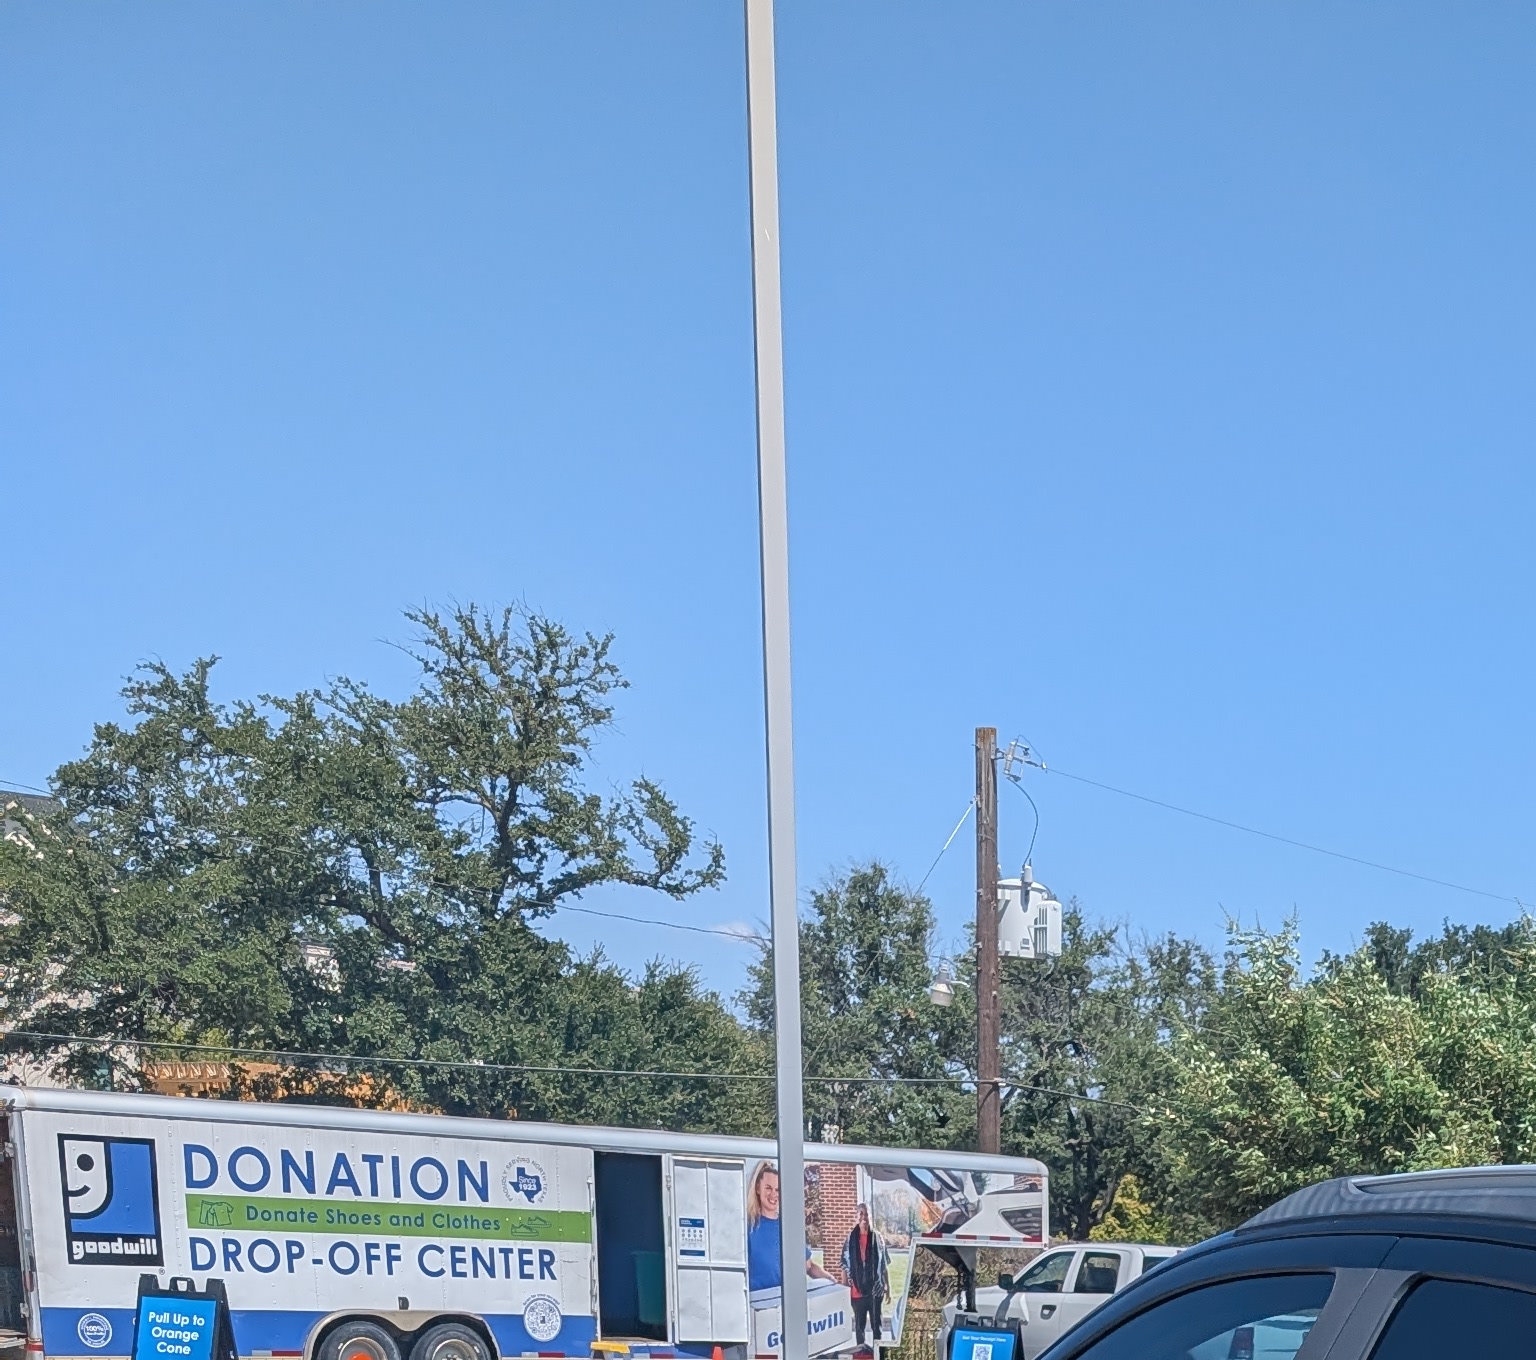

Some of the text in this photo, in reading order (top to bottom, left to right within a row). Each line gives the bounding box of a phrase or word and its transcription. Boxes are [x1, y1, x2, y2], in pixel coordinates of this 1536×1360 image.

[183, 1143, 490, 1203] DONATION
[245, 1205, 501, 1231] Donate Shoes and Clothes
[72, 1237, 158, 1260] goodwill
[189, 1236, 558, 1281] DROP-OFF CENTER
[148, 1311, 205, 1328] Pull Up to
[767, 1310, 844, 1348] Gwill
[151, 1326, 200, 1343] Orange
[156, 1341, 192, 1355] Cone
